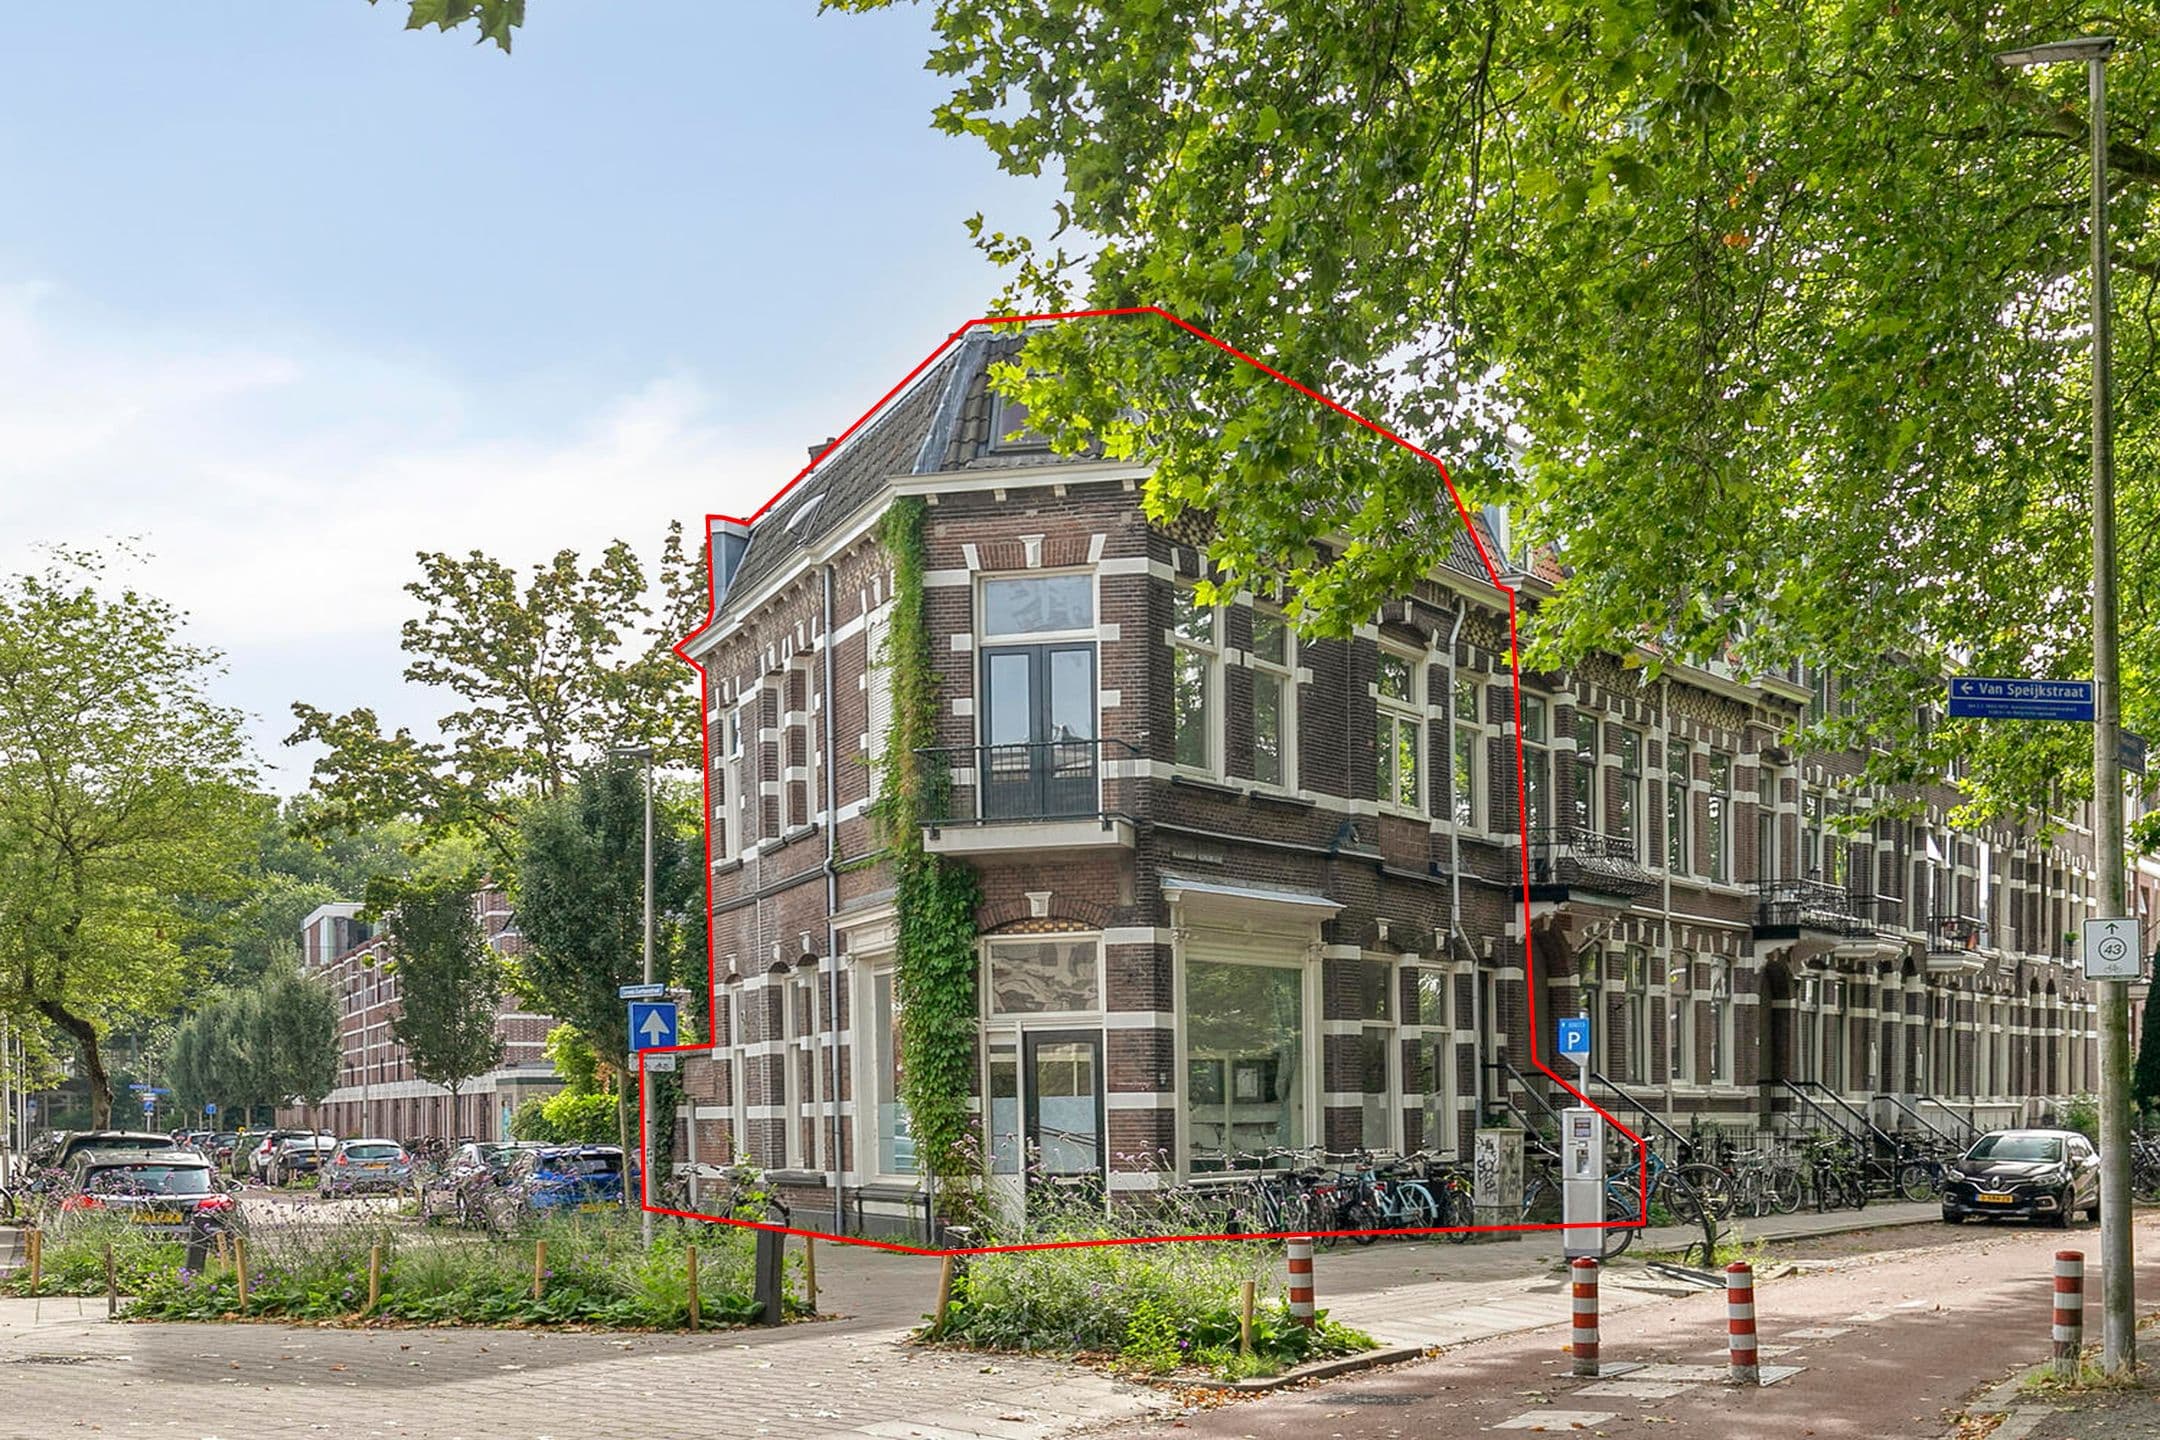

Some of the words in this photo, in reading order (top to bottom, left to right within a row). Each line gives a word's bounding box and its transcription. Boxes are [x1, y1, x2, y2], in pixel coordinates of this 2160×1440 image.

[1979, 682, 2003, 695] Van
[2007, 683, 2085, 699] Speijkstraat
[2103, 944, 2122, 955] 43
[1568, 1031, 1581, 1051] P
